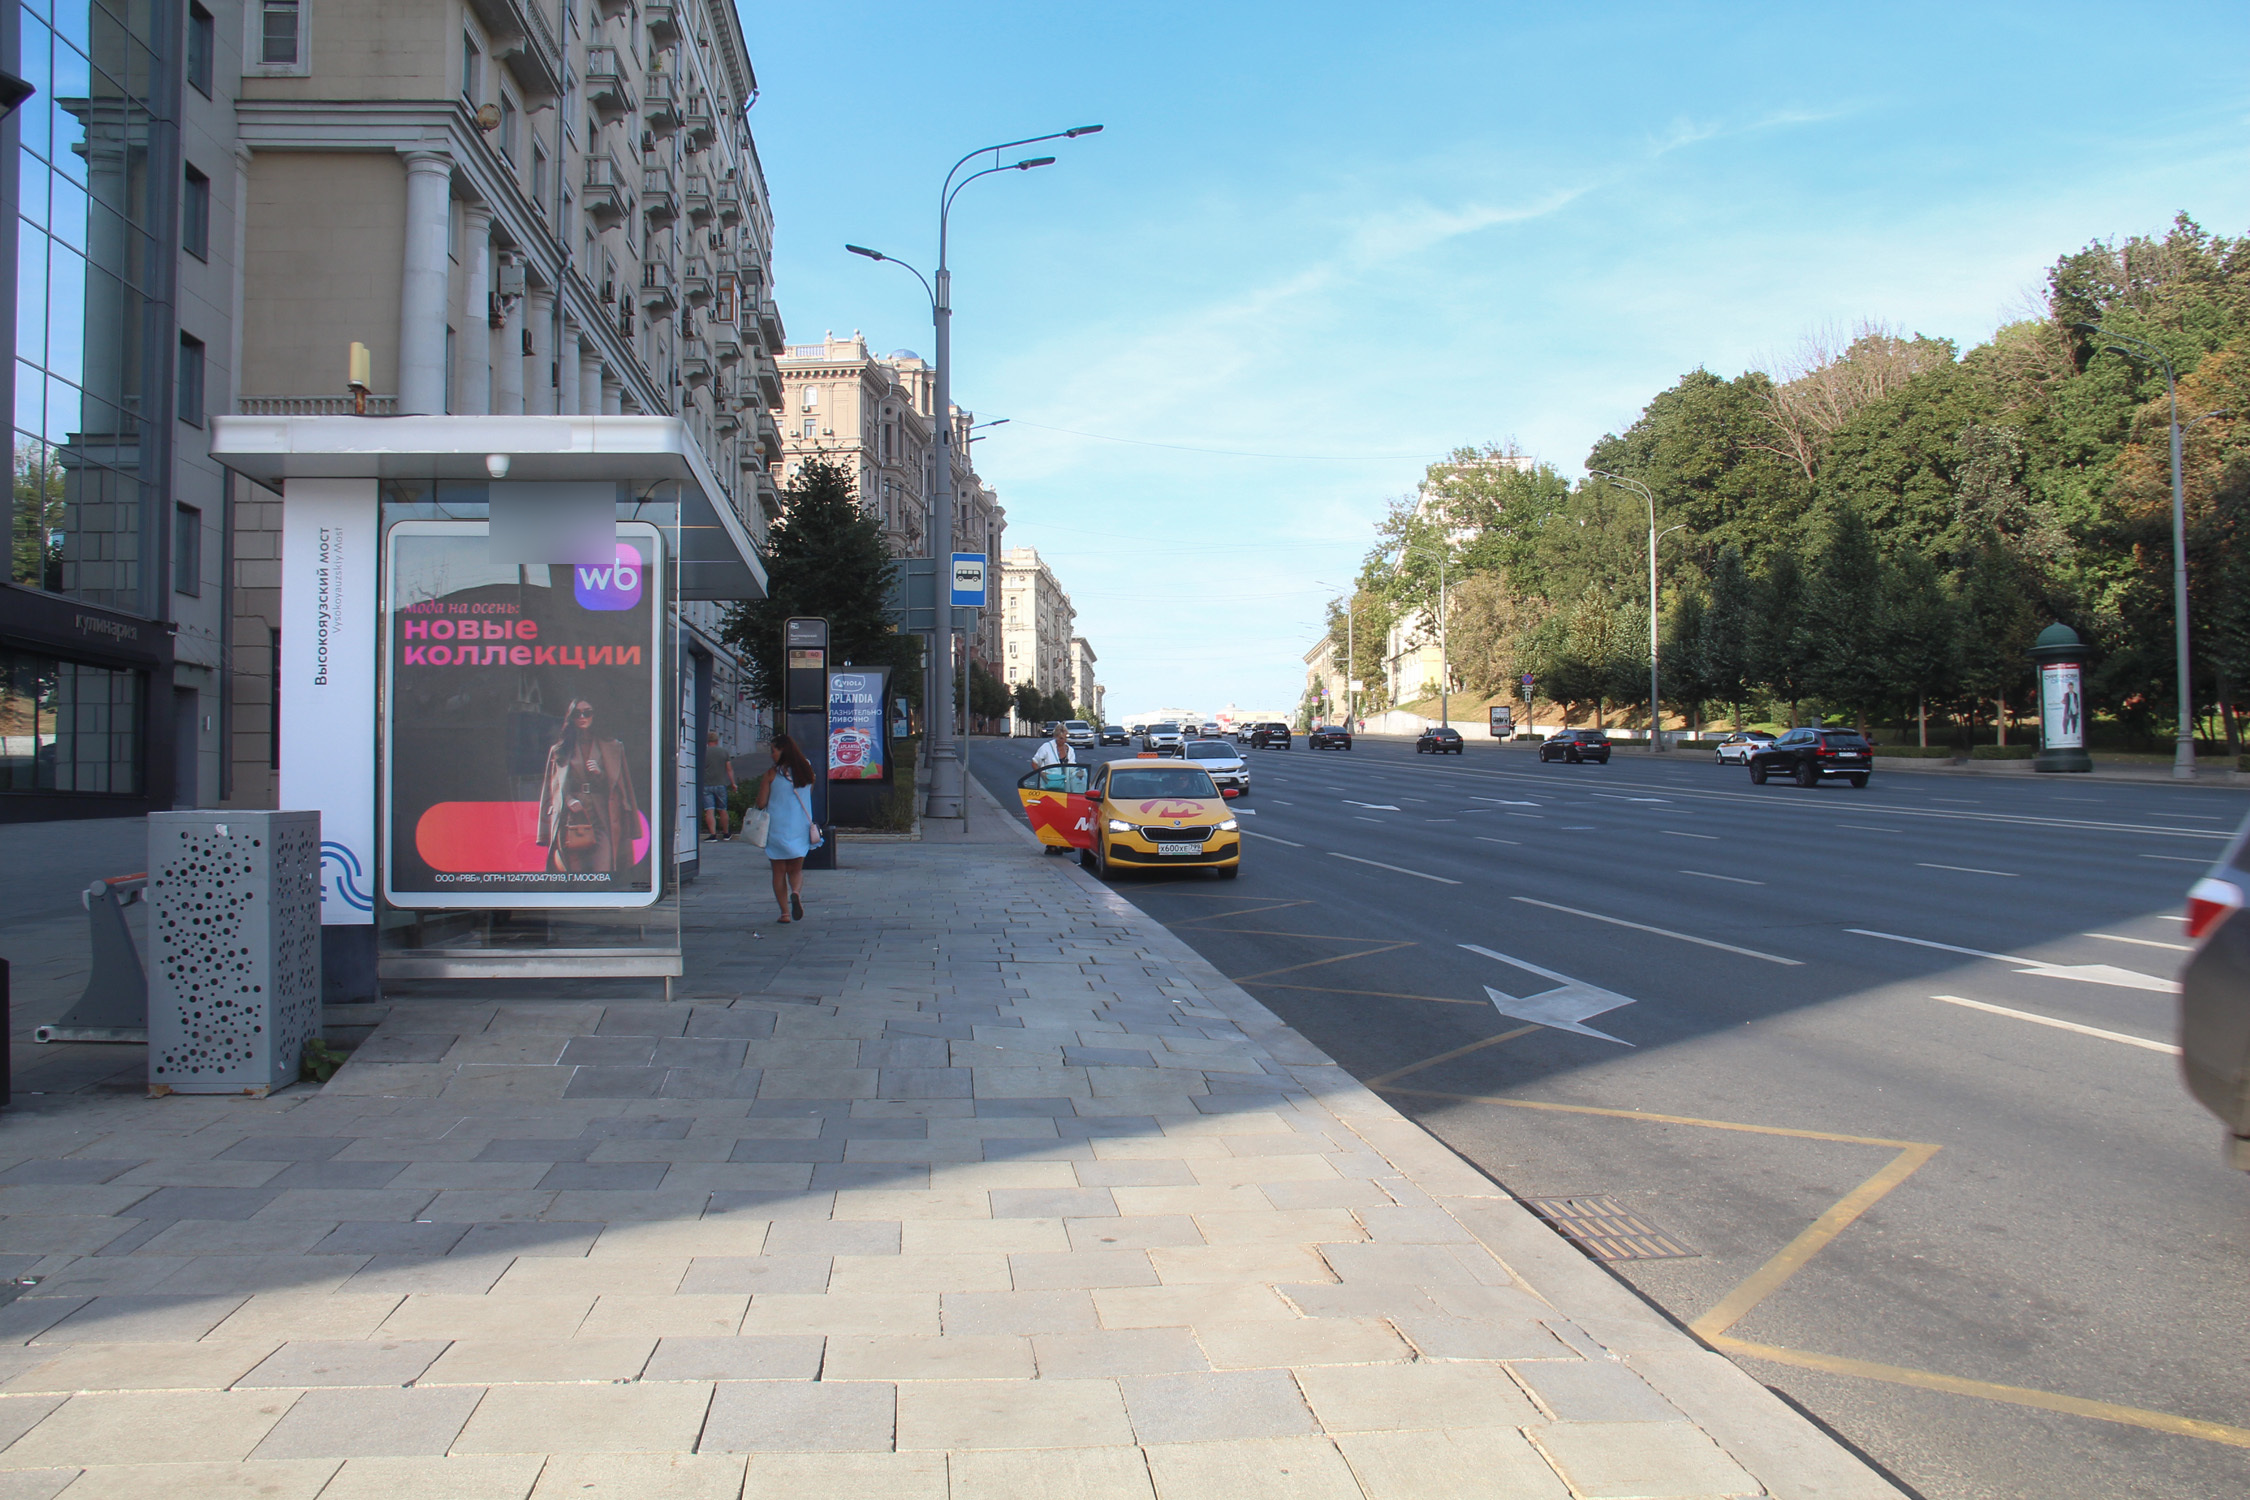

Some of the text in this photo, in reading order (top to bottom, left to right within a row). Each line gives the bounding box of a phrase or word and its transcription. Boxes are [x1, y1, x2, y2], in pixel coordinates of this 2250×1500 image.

[333, 527, 345, 634] Vysokoyauzskiy Most
[578, 558, 638, 591] wb
[314, 527, 331, 686] Высокояузский мост
[449, 602, 469, 614] на
[472, 602, 520, 615] осень:
[75, 614, 137, 642] кулинария
[404, 619, 538, 640] новые
[404, 645, 641, 669] коллекции
[435, 873, 455, 882] ООО
[483, 873, 506, 882] ОГРН
